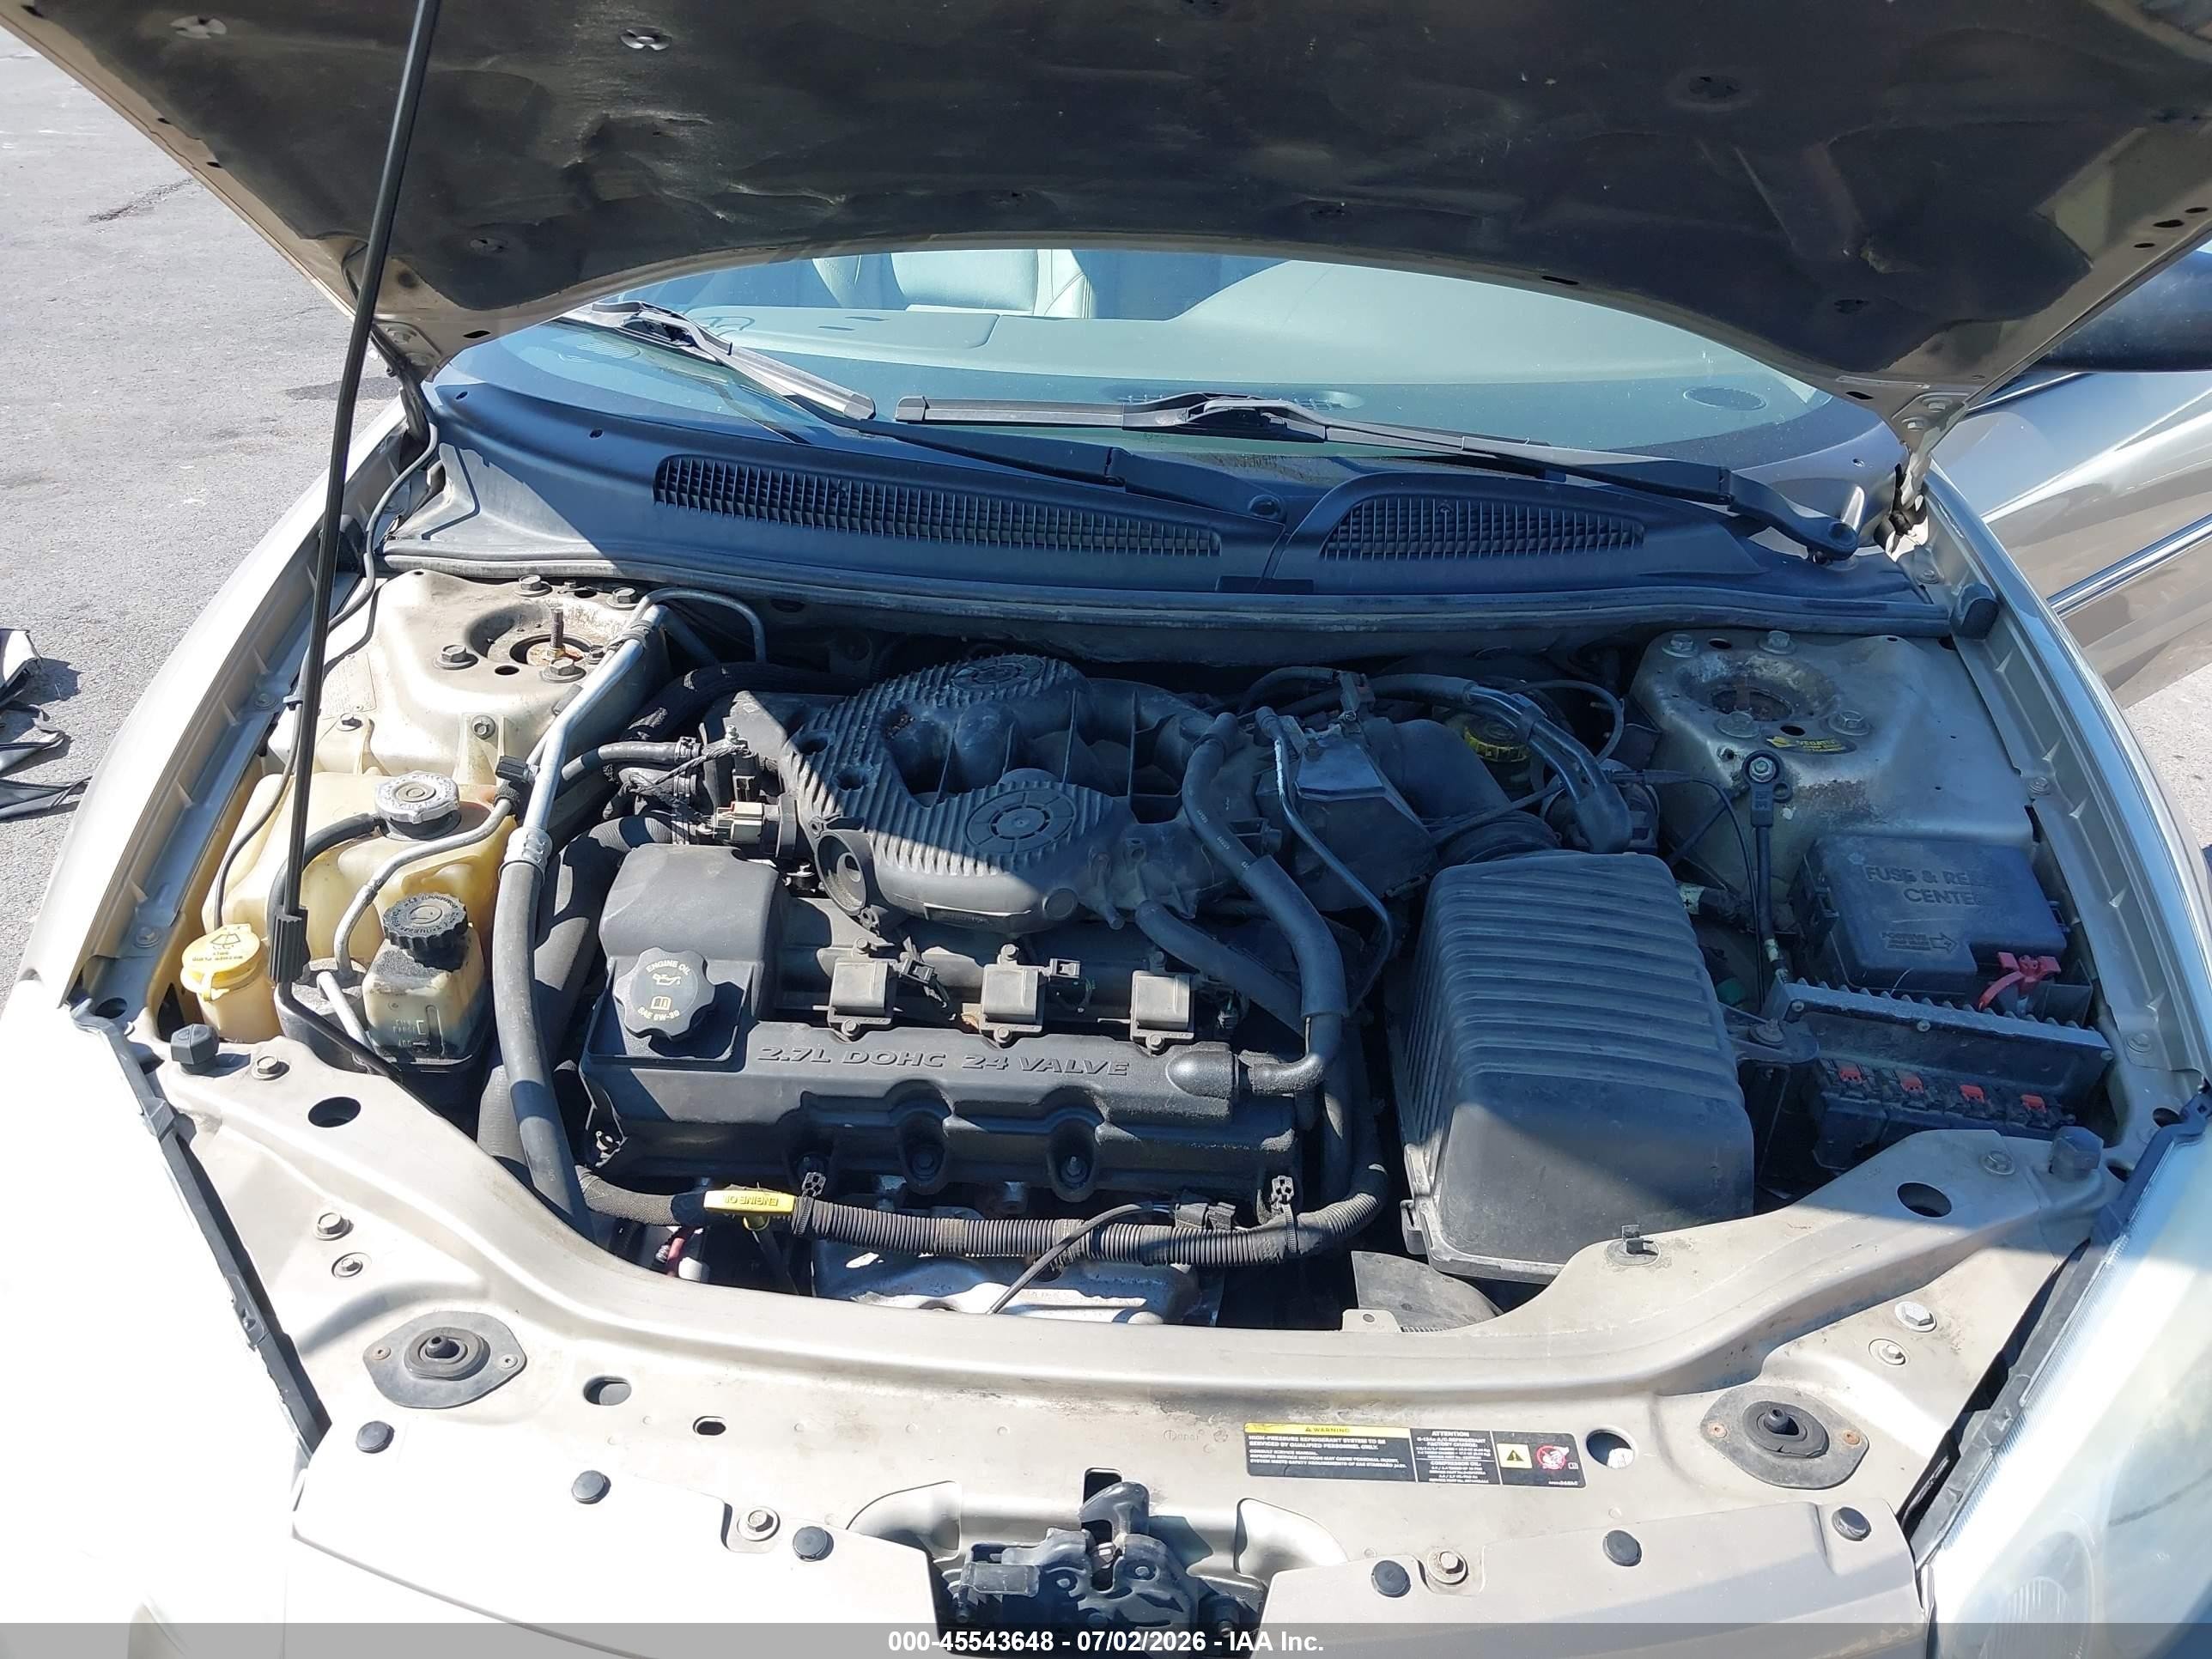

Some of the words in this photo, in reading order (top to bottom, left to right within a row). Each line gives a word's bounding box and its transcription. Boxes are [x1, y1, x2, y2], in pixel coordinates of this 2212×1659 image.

[1865, 866, 1917, 883] FUSE
[1922, 870, 1938, 884] &
[646, 960, 678, 973] ENGINE
[678, 963, 691, 975] OIL
[638, 1006, 653, 1019] SAE
[757, 1046, 832, 1064] 2.7L
[842, 1050, 946, 1067] DOHC
[961, 1055, 1009, 1071] 24
[1016, 1056, 1130, 1077] VALVE
[739, 1195, 779, 1206] ENGINE
